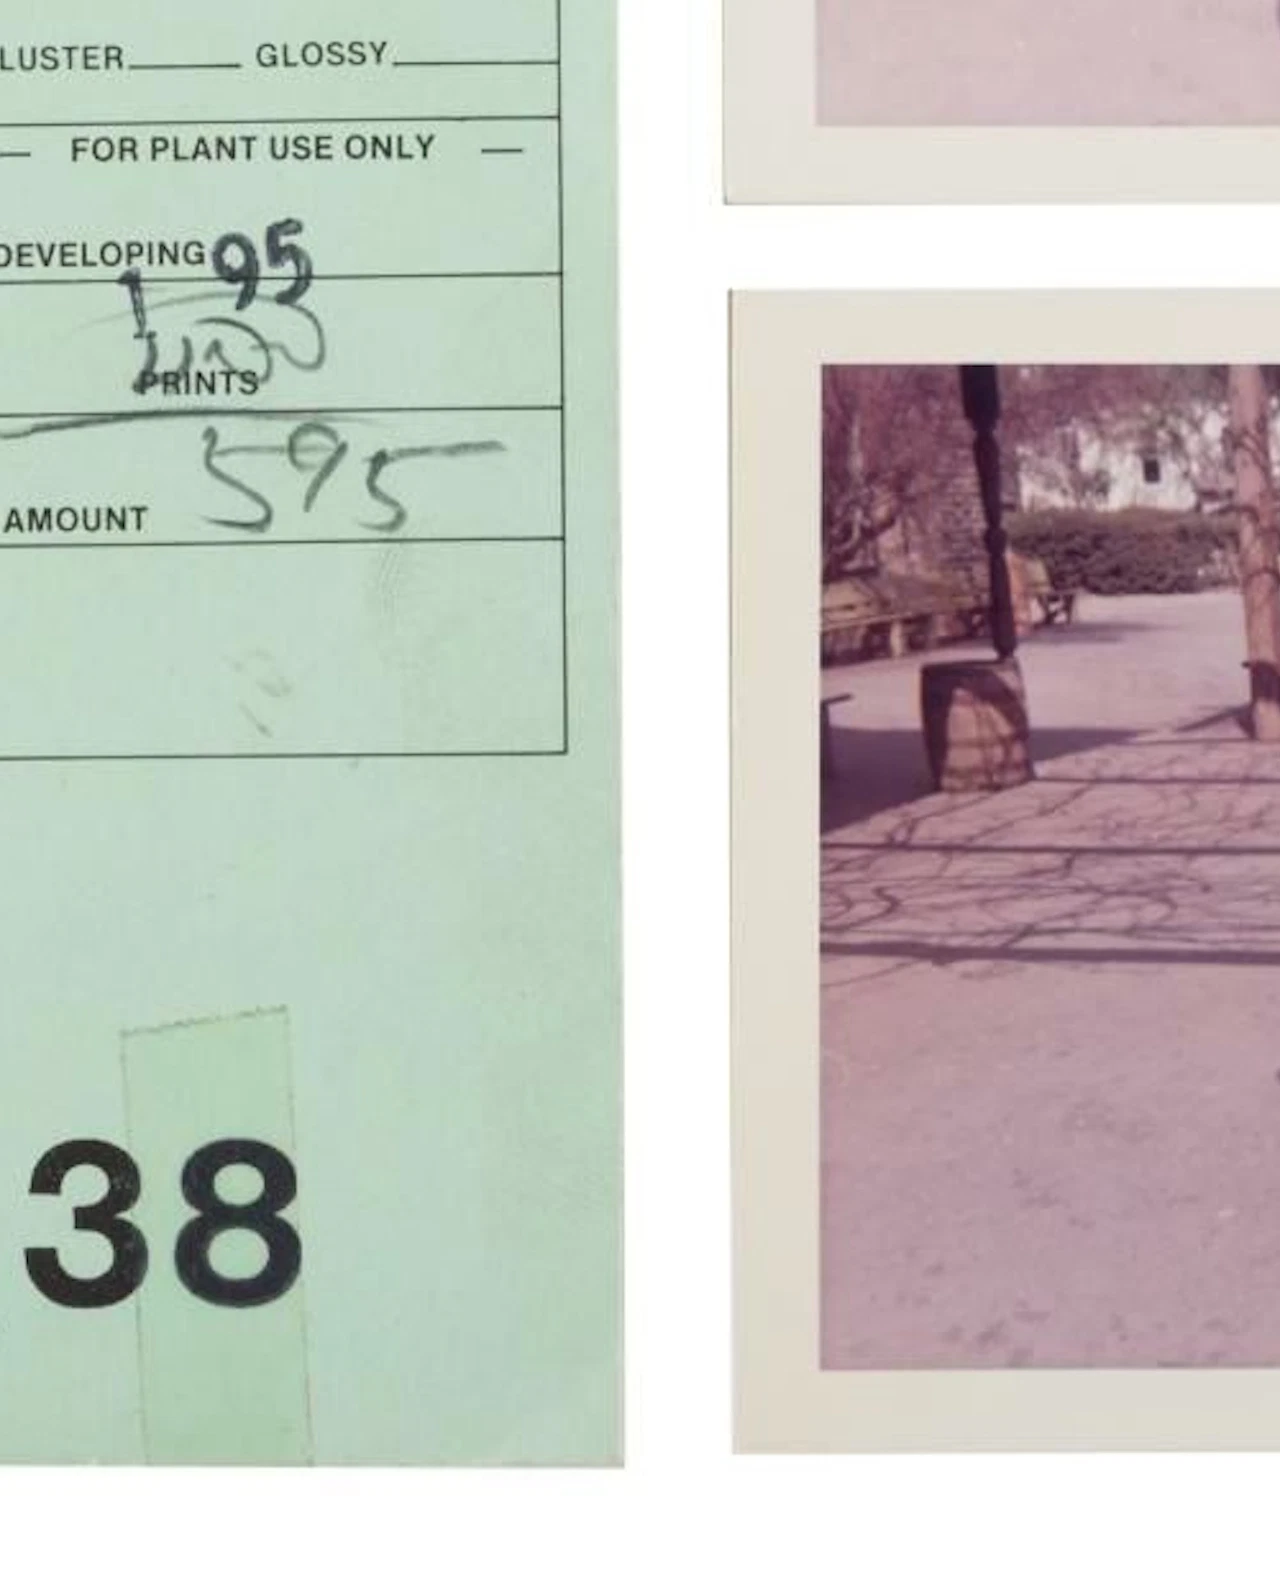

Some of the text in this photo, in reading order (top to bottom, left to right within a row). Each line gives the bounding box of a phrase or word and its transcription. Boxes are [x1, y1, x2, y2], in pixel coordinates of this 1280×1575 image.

[0, 44, 124, 72] LUSTER
[255, 40, 388, 69] GLOSSY
[71, 133, 435, 163] FOR PLANT USE ONLY
[212, 217, 314, 312] 95
[137, 369, 260, 396] PRINTS
[202, 422, 506, 534] 595
[2, 505, 149, 534] AMOUNT
[23, 1137, 303, 1310] 38
